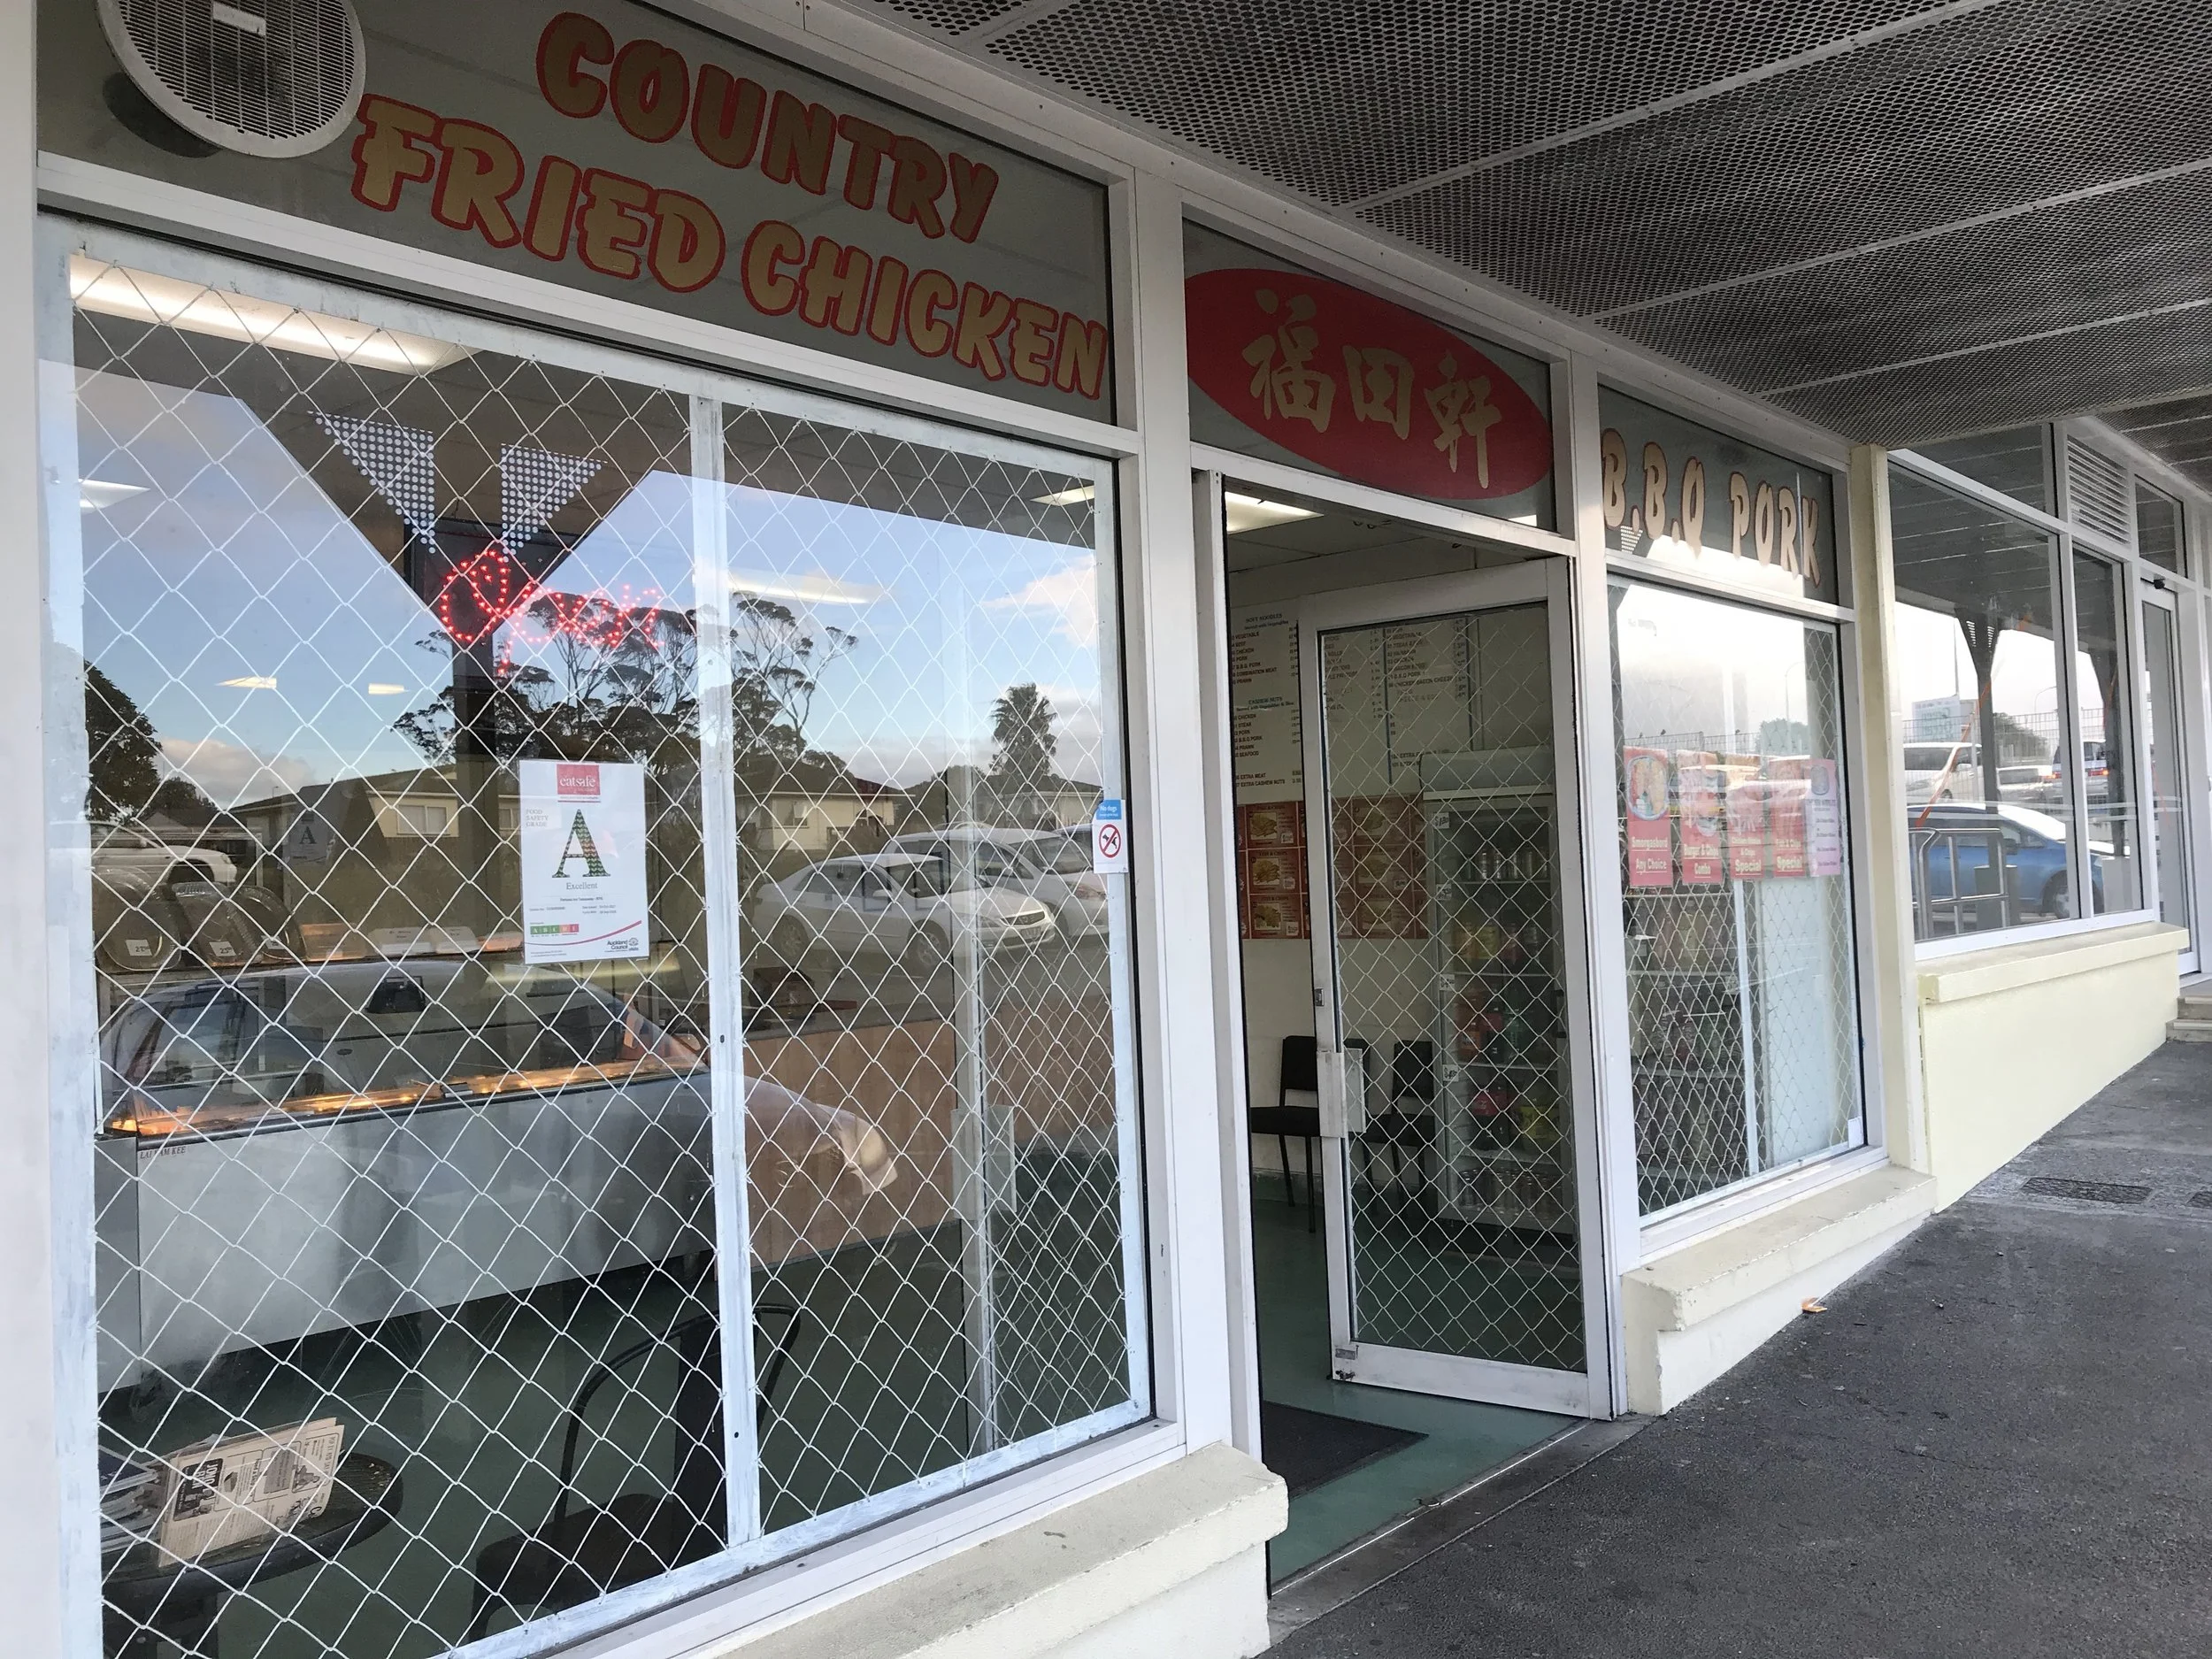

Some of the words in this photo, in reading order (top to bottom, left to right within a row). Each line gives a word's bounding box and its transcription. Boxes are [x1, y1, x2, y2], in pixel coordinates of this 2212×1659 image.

[536, 12, 1000, 244] COUNTRY
[351, 92, 726, 293] FRIED
[741, 219, 1107, 401] CHICKEN
[1730, 470, 1821, 588] PORK
[559, 774, 596, 787] eatsafe
[551, 808, 611, 879] A
[1777, 856, 1802, 872] Special
[565, 881, 598, 891] Excellent
[1734, 859, 1762, 875] Special
